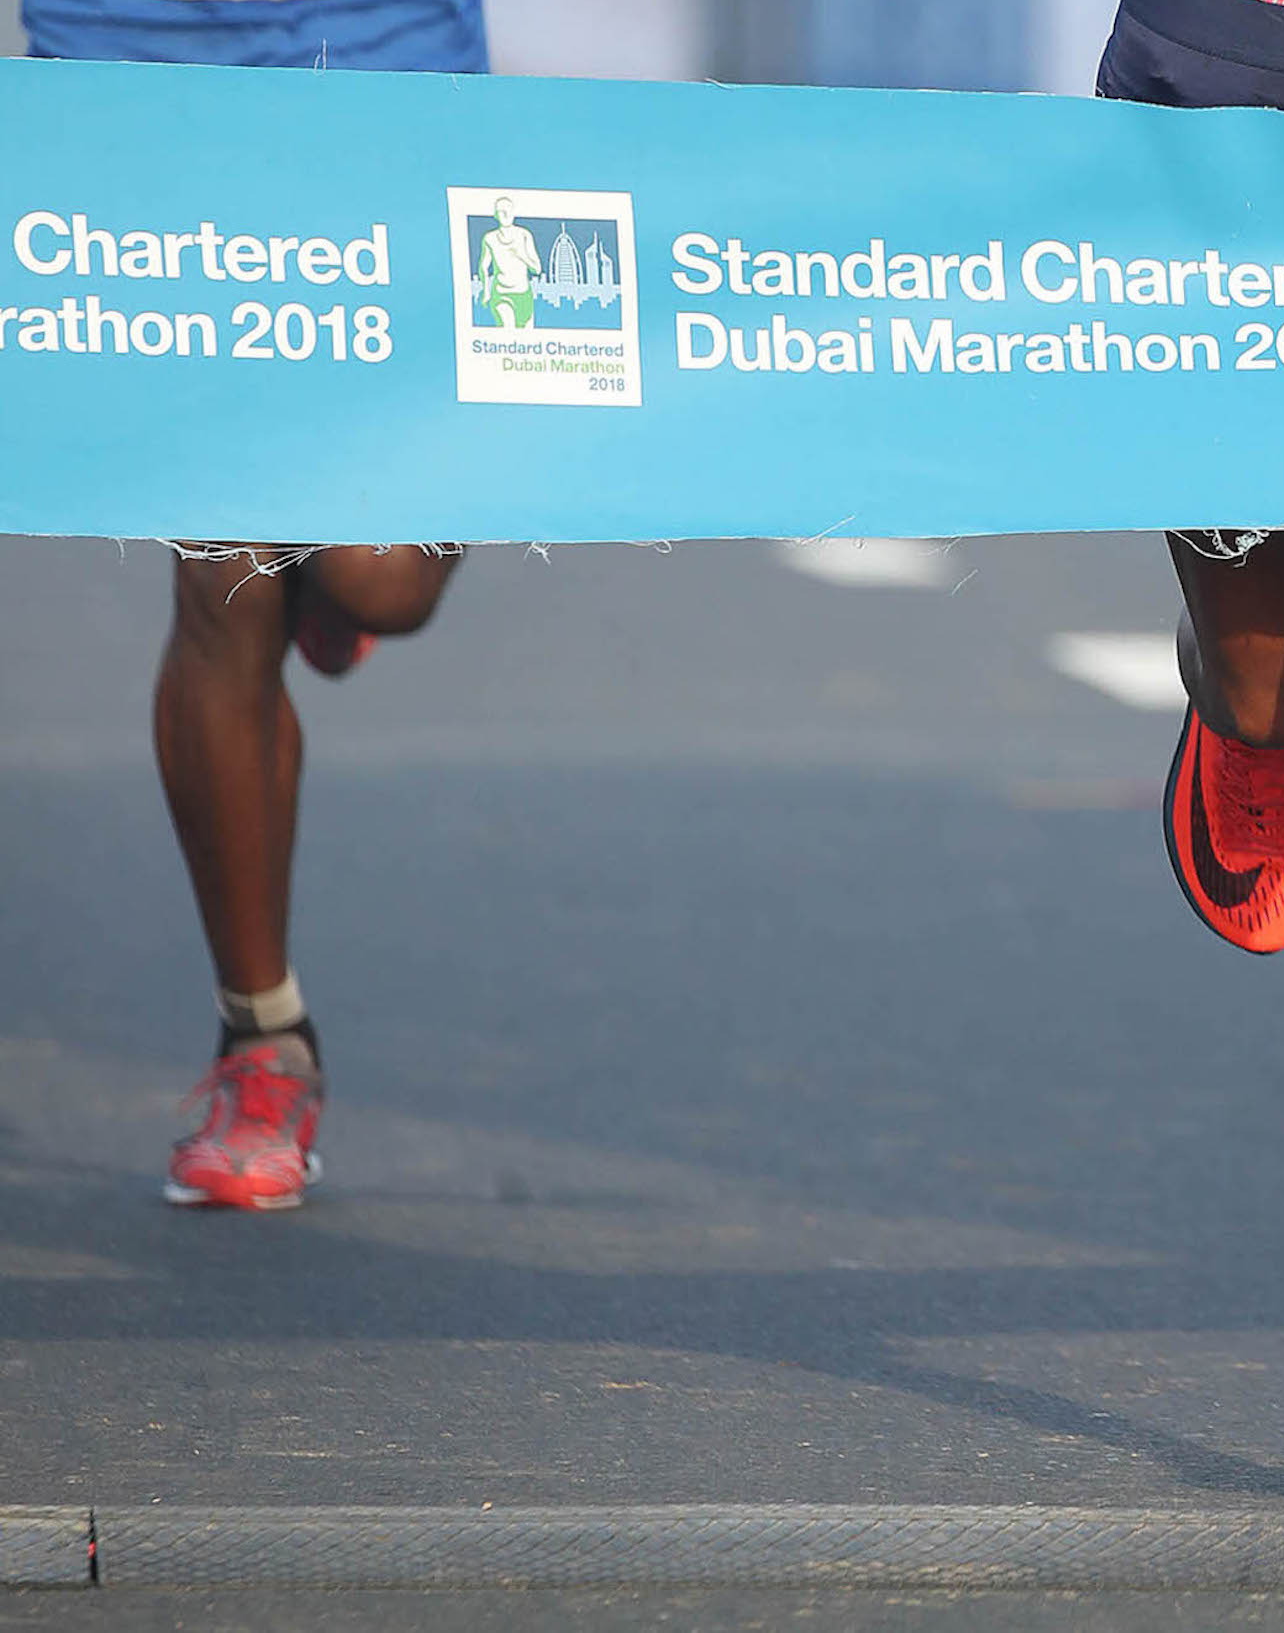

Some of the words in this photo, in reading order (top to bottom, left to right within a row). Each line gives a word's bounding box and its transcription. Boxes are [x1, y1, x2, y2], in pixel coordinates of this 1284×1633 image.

[13, 211, 390, 286] Chartered
[672, 233, 1006, 302] Standard
[231, 301, 393, 363] 2018
[472, 339, 542, 355] Standard
[545, 341, 624, 357] Chartered
[676, 312, 875, 373] Dubai
[890, 317, 1220, 373] Marathon
[502, 358, 546, 373] Dubai
[550, 359, 625, 374] Marathon
[588, 377, 625, 392] 2018
